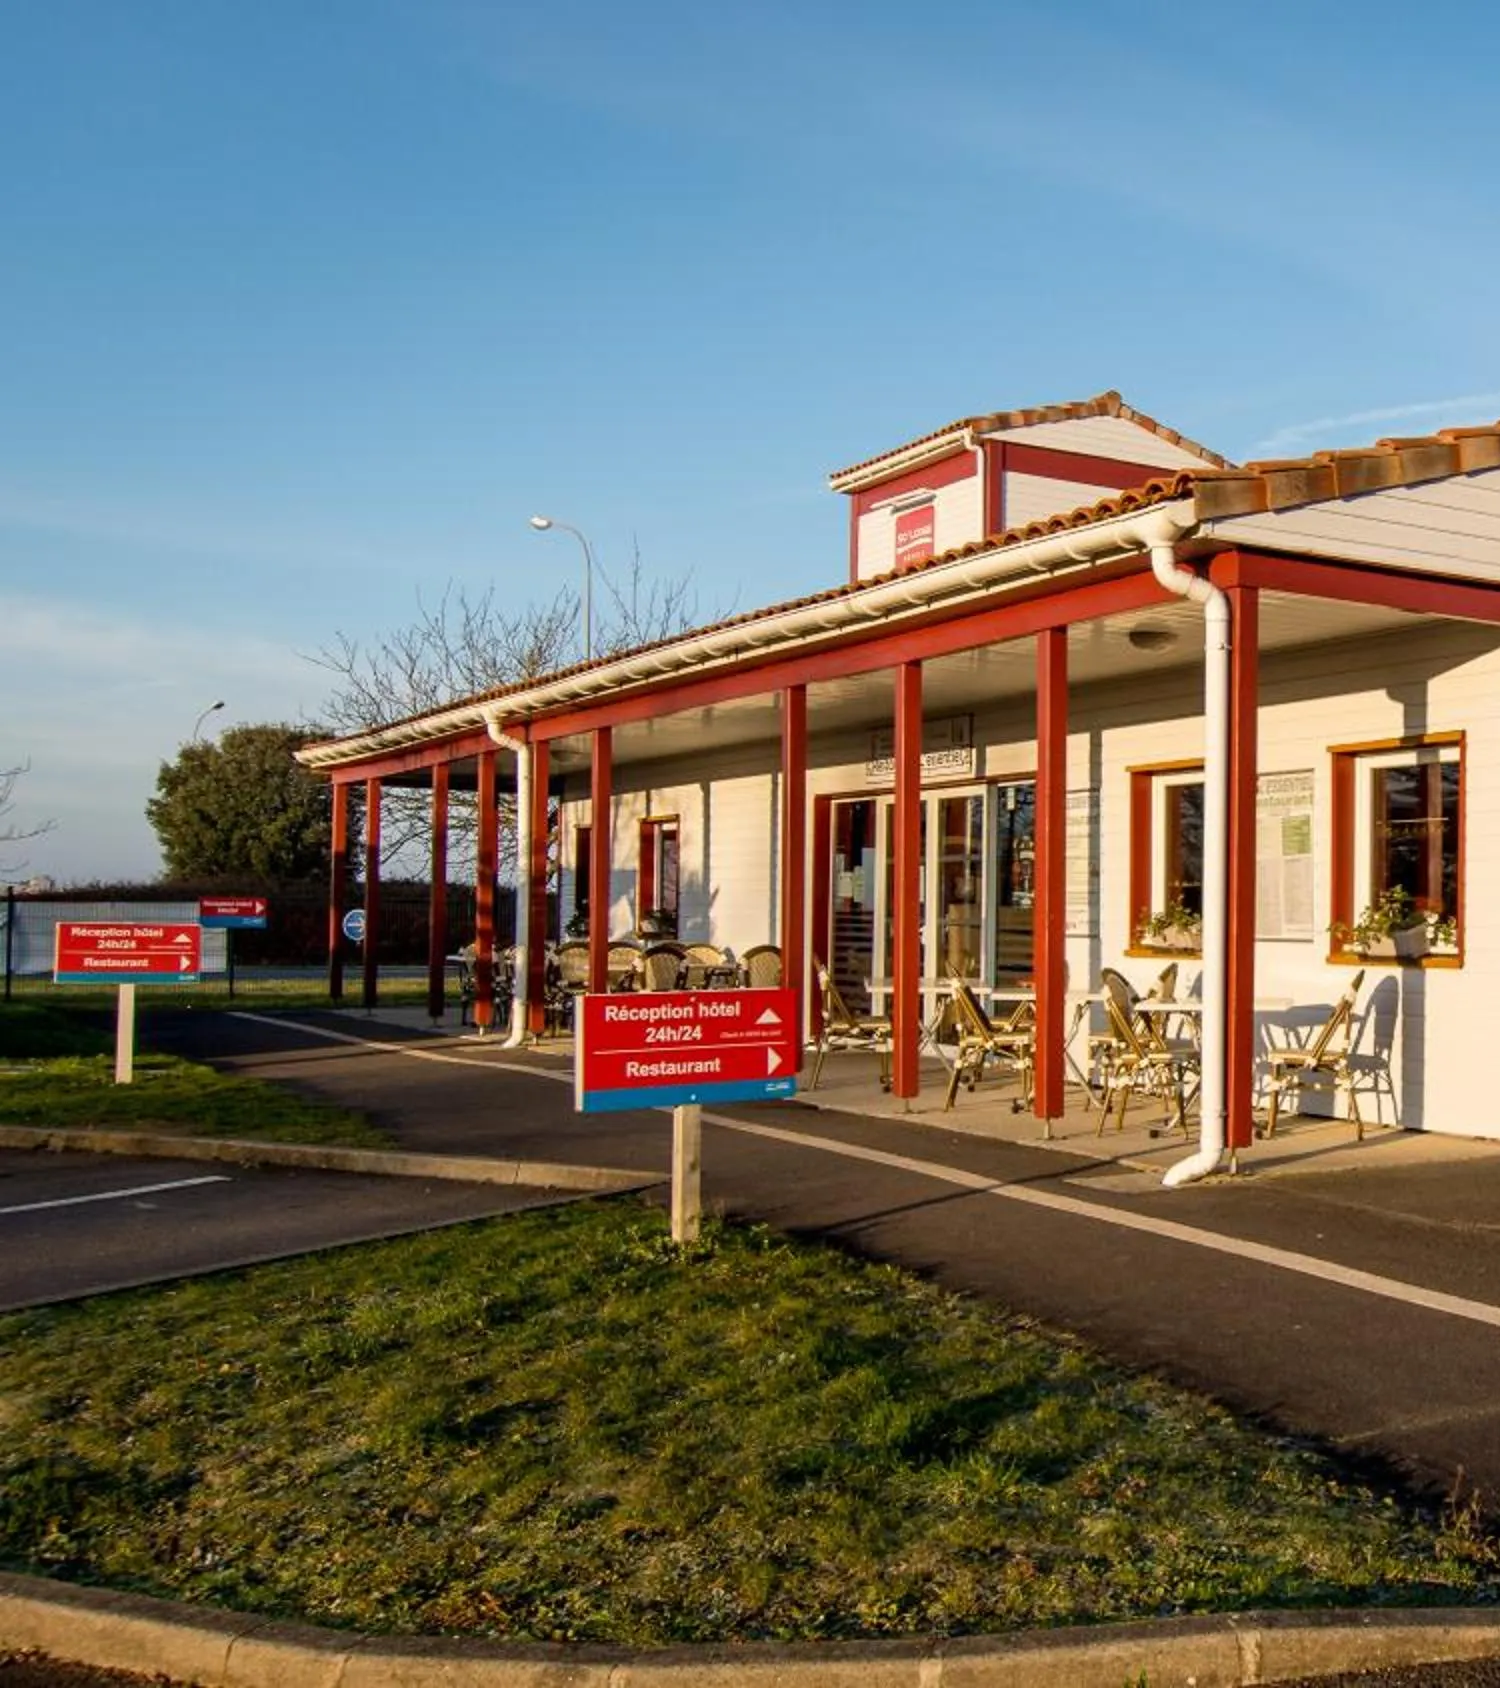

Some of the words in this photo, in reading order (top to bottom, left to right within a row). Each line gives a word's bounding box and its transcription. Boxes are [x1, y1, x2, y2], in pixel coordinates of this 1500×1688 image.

[71, 927, 131, 938] Réception
[133, 927, 164, 937] hôtel
[97, 939, 137, 949] 24h/24
[83, 957, 149, 967] Restaurant
[604, 1003, 693, 1024] Réception
[698, 1001, 741, 1018] hôtel
[645, 1025, 702, 1044] 24h/24
[625, 1057, 721, 1078] Restaurant
